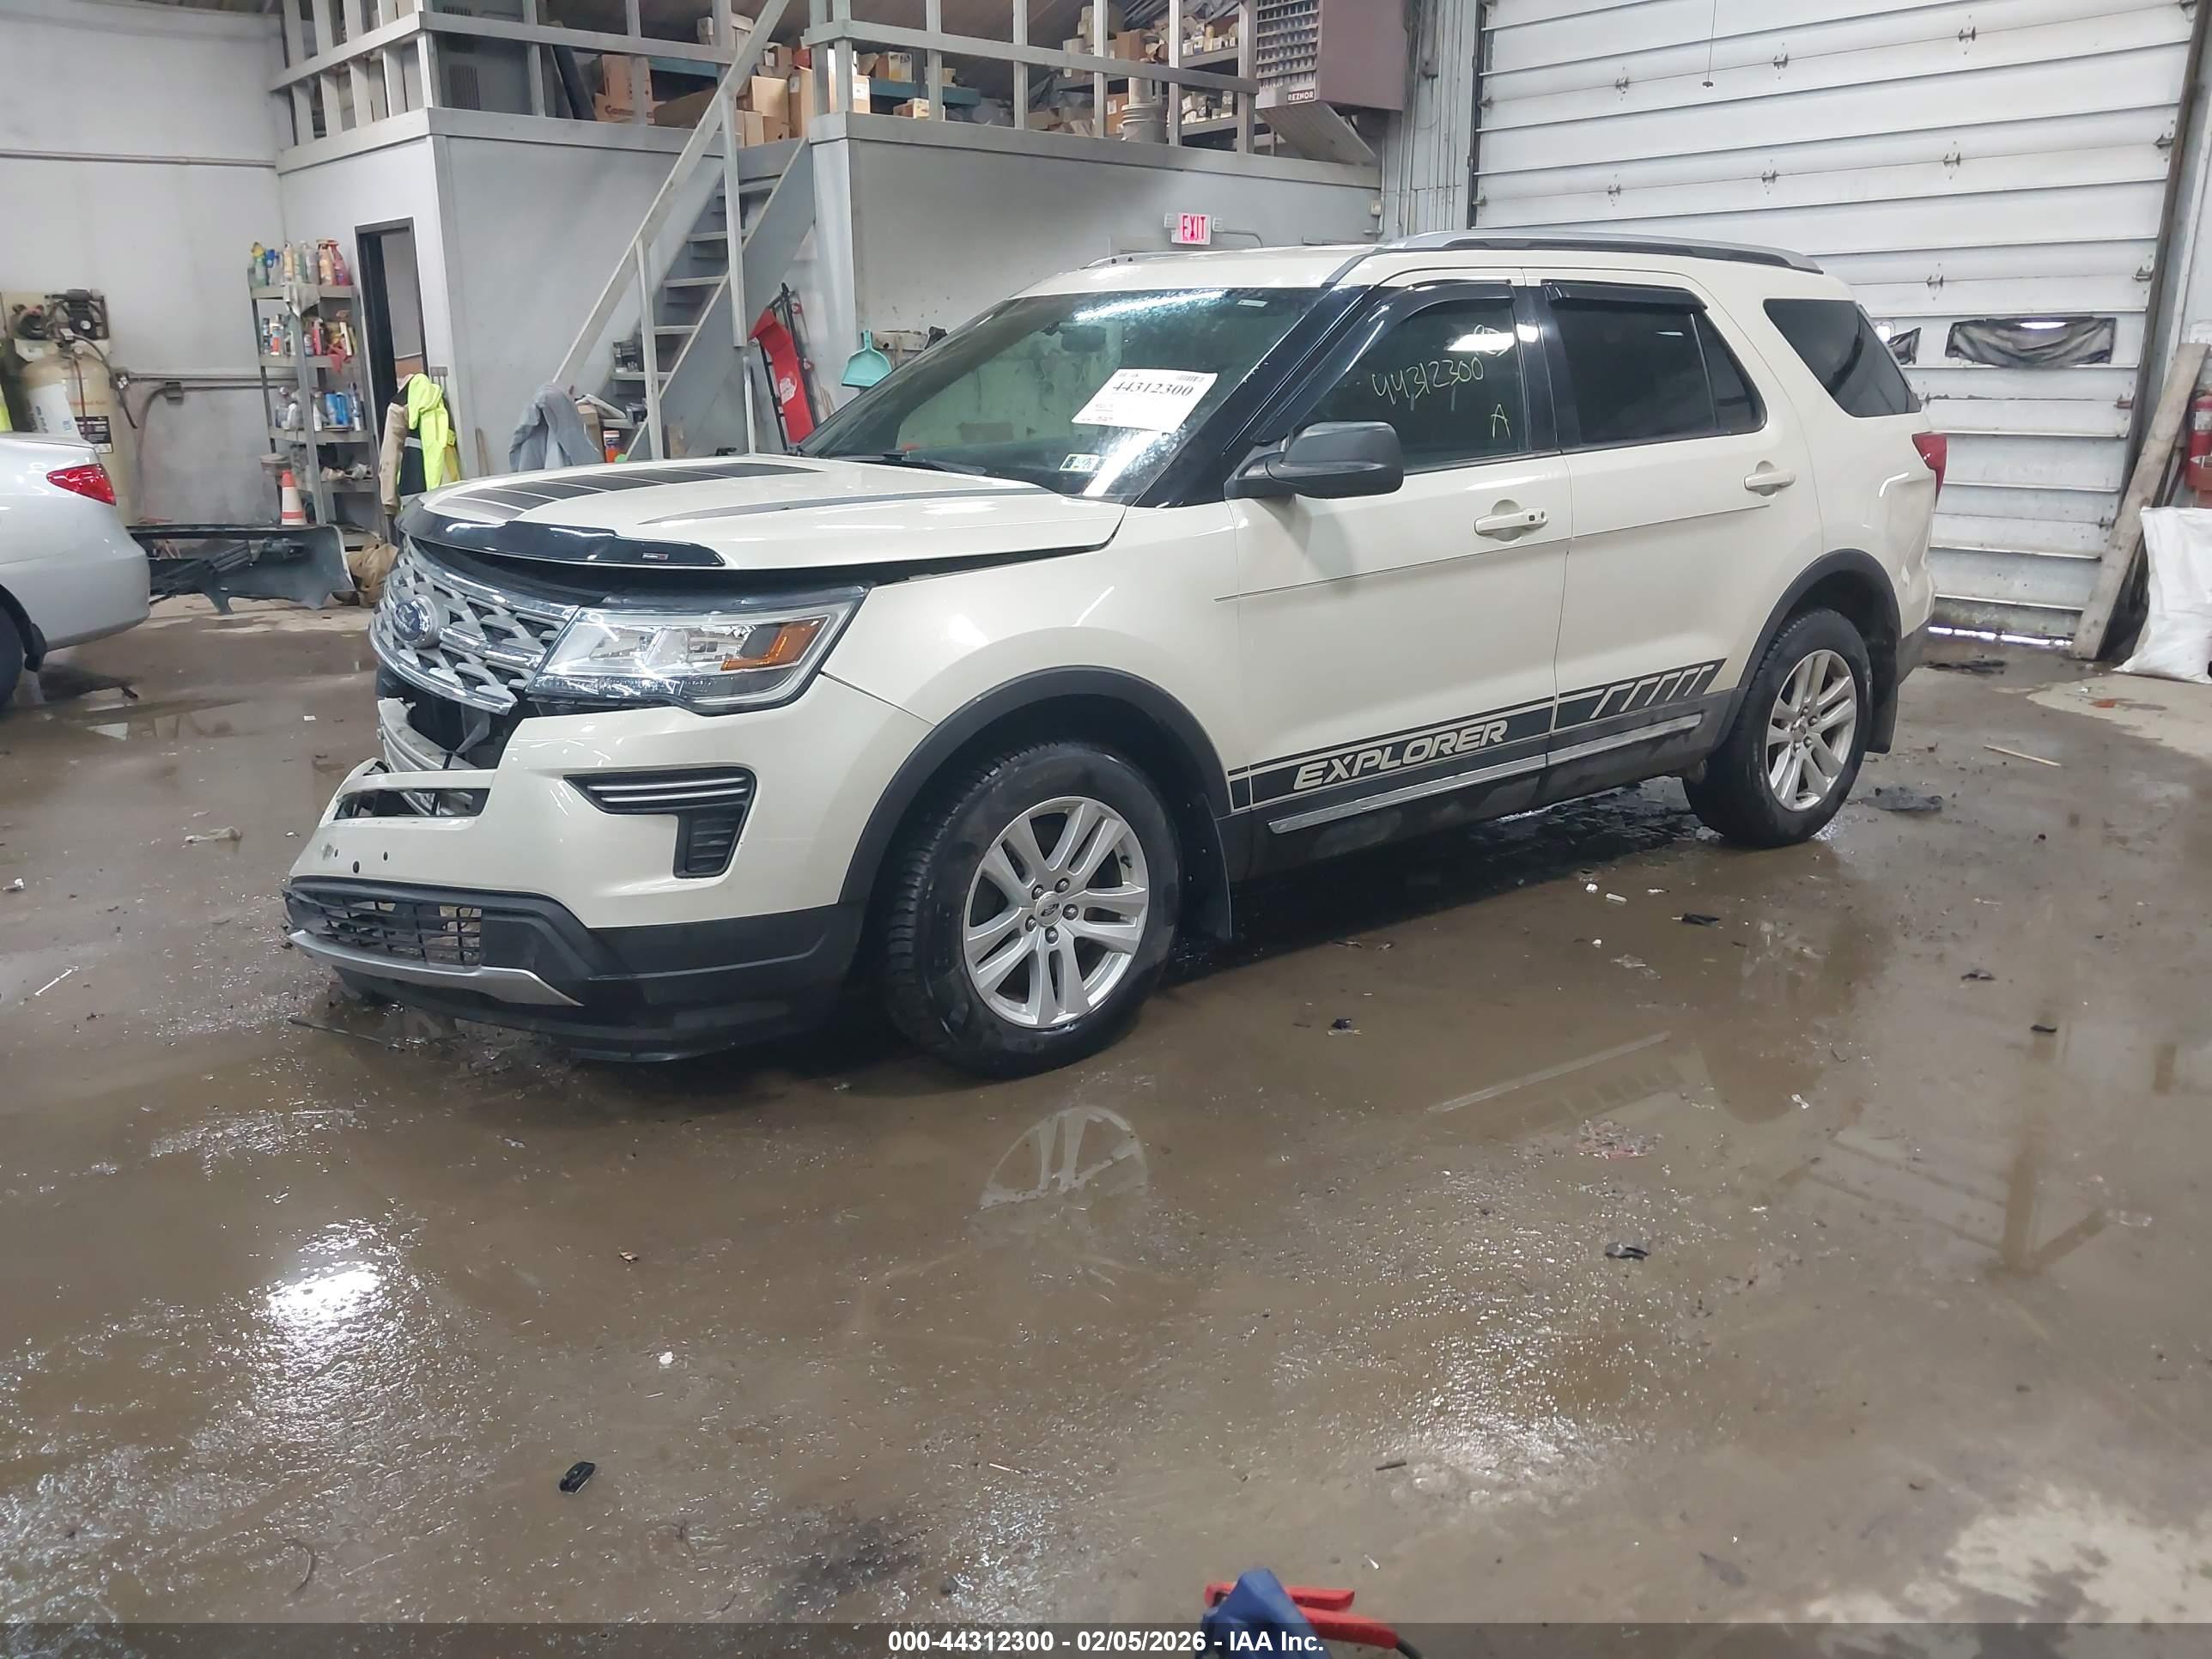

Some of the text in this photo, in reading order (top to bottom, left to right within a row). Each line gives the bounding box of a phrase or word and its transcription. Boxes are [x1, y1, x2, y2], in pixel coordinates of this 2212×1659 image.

[1182, 215, 1206, 240] EXIT
[1113, 381, 1194, 396] 44312300
[1371, 356, 1484, 404] 44312300
[1490, 404, 1510, 440] A
[1293, 720, 1508, 790] EXPLORER
